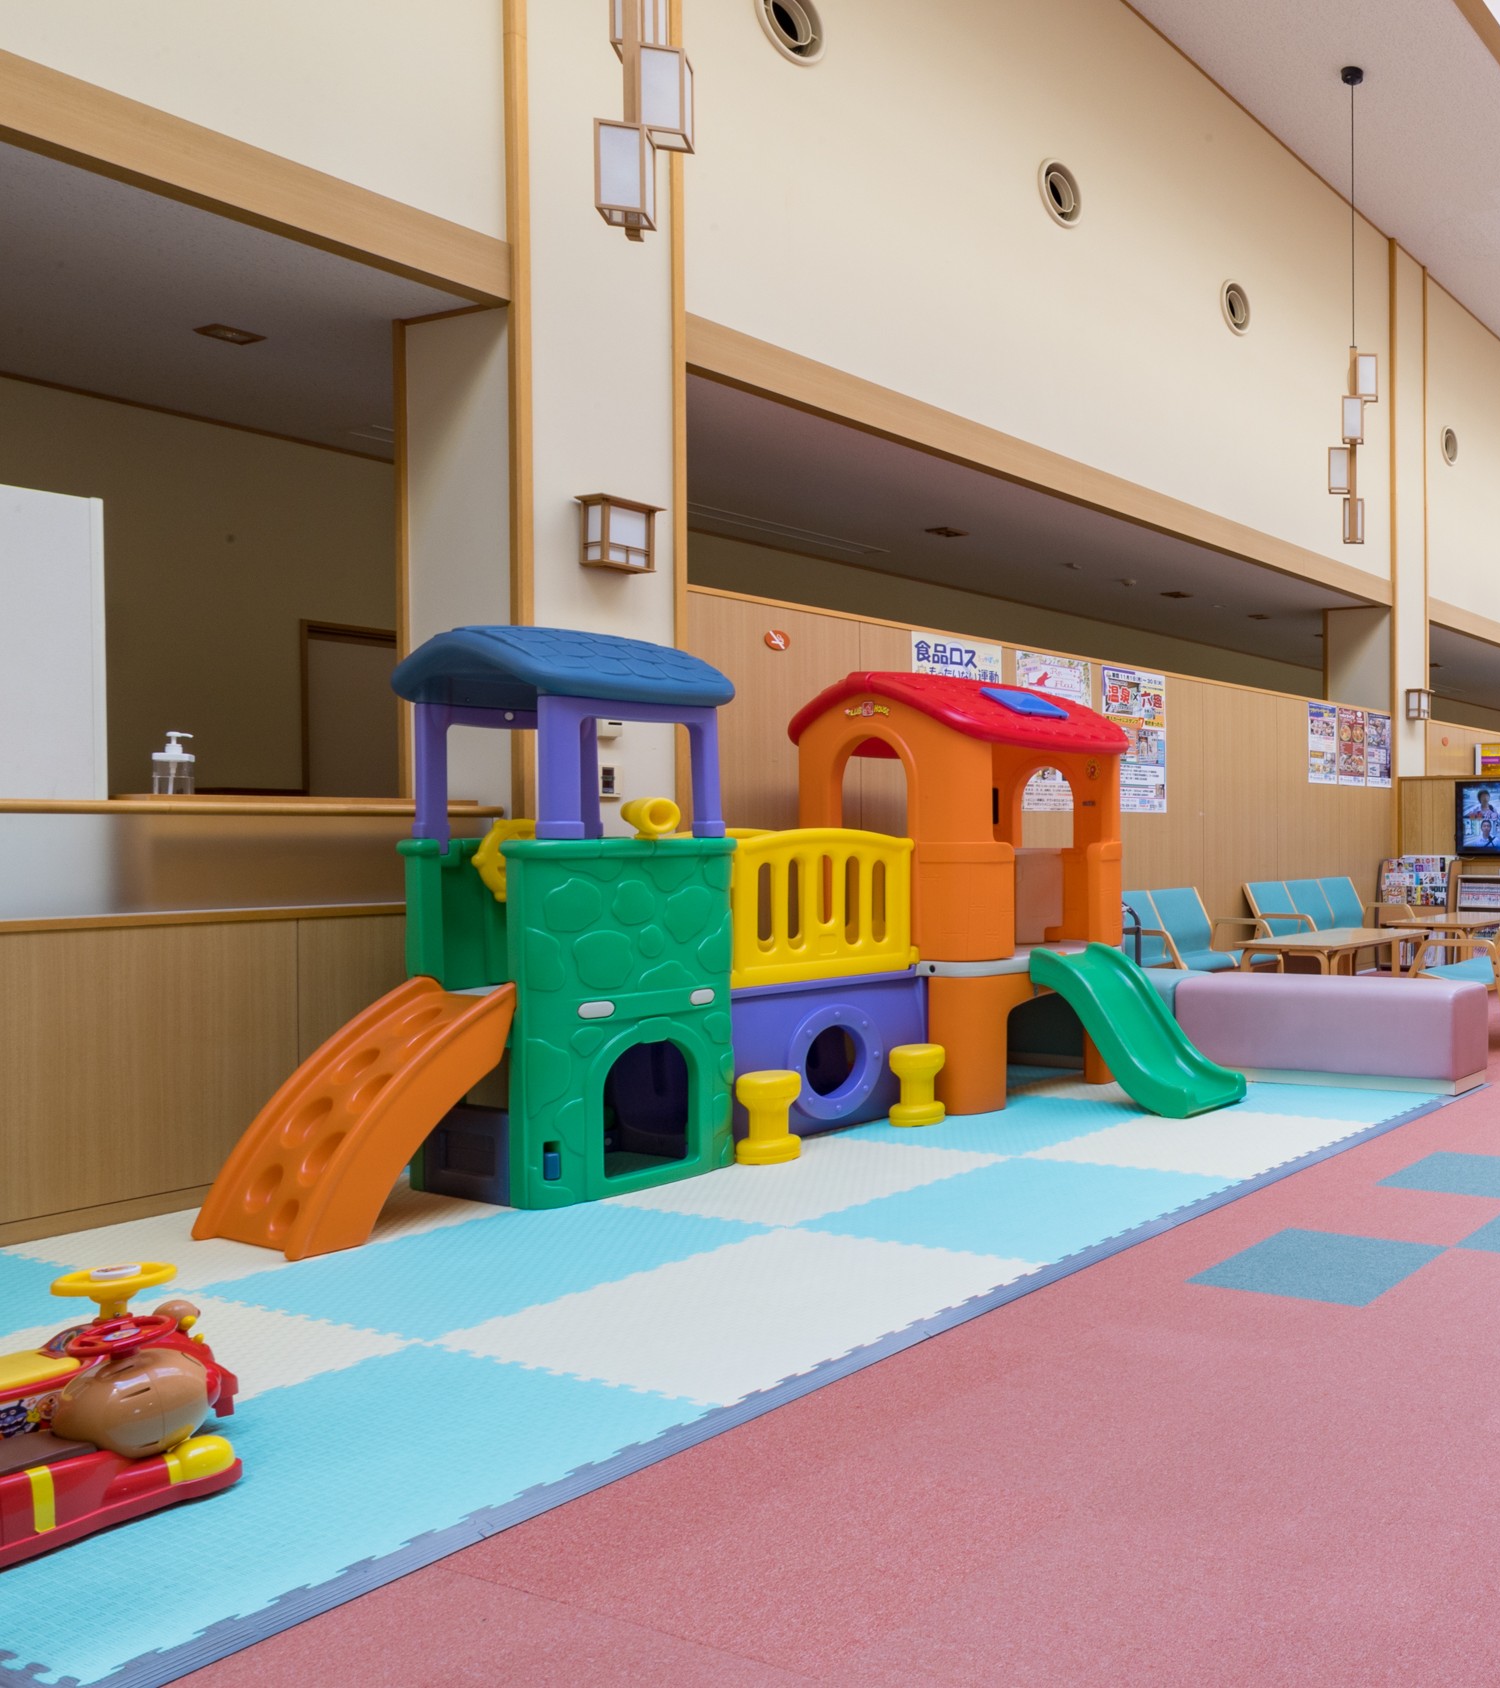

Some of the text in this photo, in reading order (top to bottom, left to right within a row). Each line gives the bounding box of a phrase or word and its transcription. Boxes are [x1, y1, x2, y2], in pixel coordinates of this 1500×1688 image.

[914, 640, 977, 669] 食品ロス
[929, 667, 1000, 684] もたいない運動
[1108, 685, 1130, 705] 温泉
